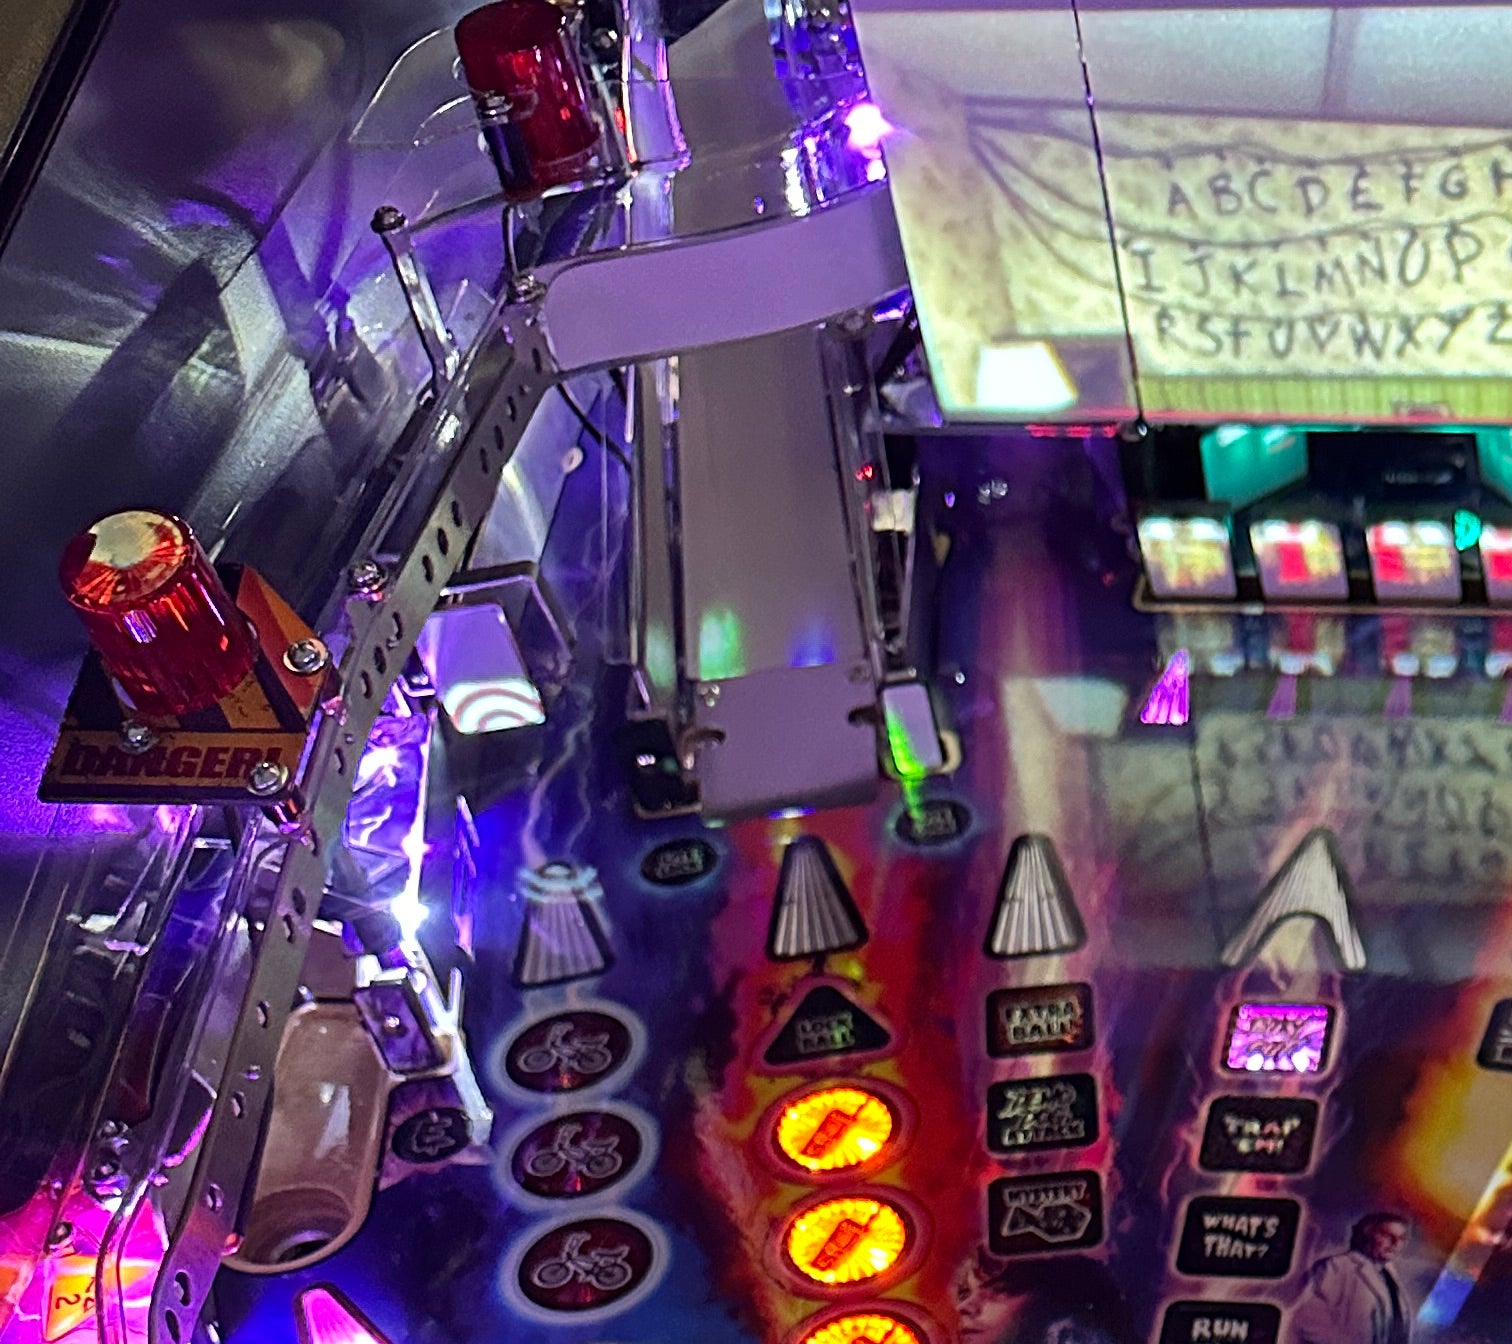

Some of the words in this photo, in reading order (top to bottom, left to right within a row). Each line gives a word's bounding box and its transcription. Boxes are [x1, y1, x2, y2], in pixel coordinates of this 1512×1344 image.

[1202, 1213, 1280, 1240] WHAT'S
[1203, 1232, 1270, 1260] THAT?
[1191, 1317, 1249, 1342] RUN
